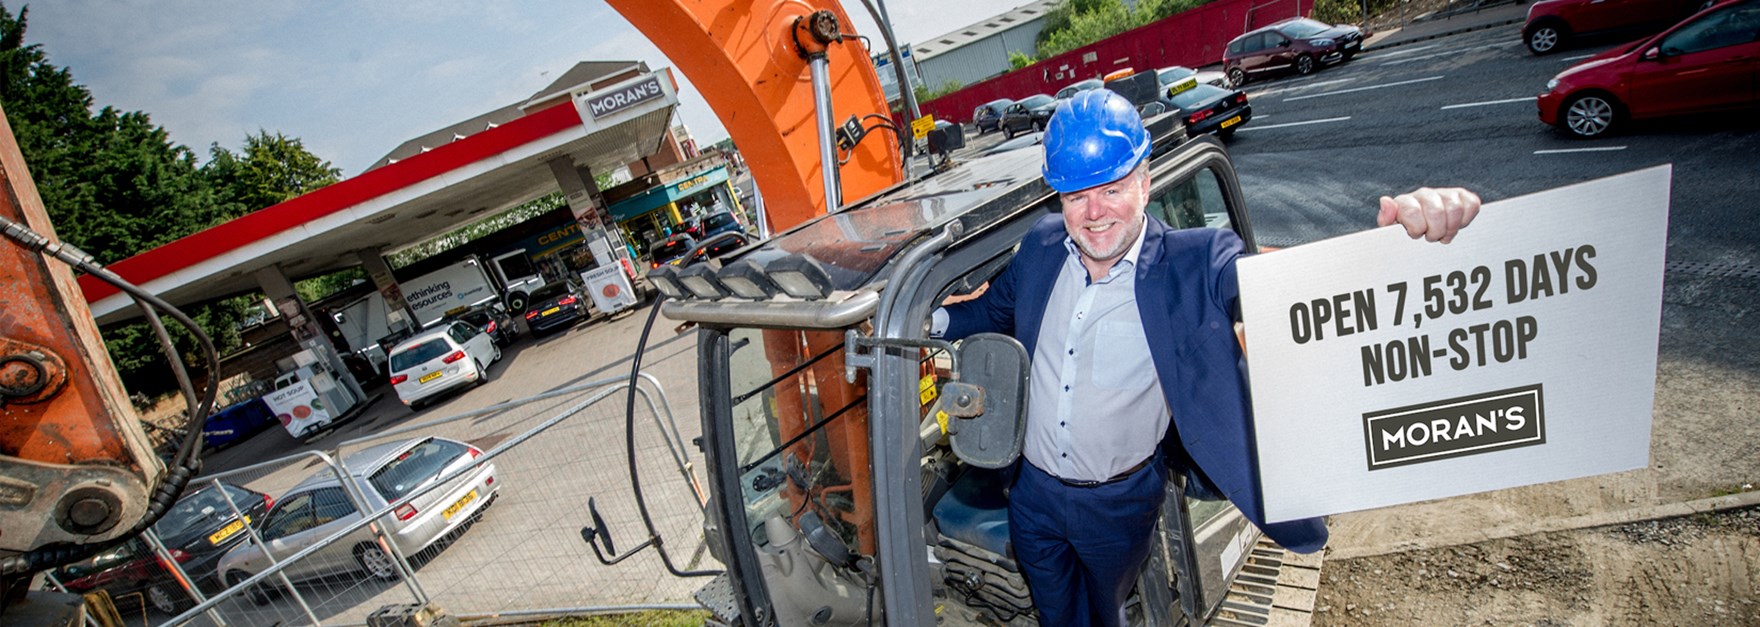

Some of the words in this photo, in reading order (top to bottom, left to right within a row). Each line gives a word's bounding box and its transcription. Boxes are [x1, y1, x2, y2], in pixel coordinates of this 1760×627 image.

[590, 80, 660, 115] MORAN'S
[678, 176, 708, 191] CENTRA
[537, 223, 581, 246] CENT
[406, 281, 451, 303] ethinking
[411, 290, 453, 311] esources
[1289, 287, 1378, 344] OPEN
[1387, 265, 1493, 329] 7,532
[1504, 244, 1598, 304] DAYS
[1360, 315, 1538, 387] NON-STOP
[273, 392, 286, 402] HOT
[286, 385, 304, 396] SOUP
[1381, 406, 1527, 451] MORAN'S
